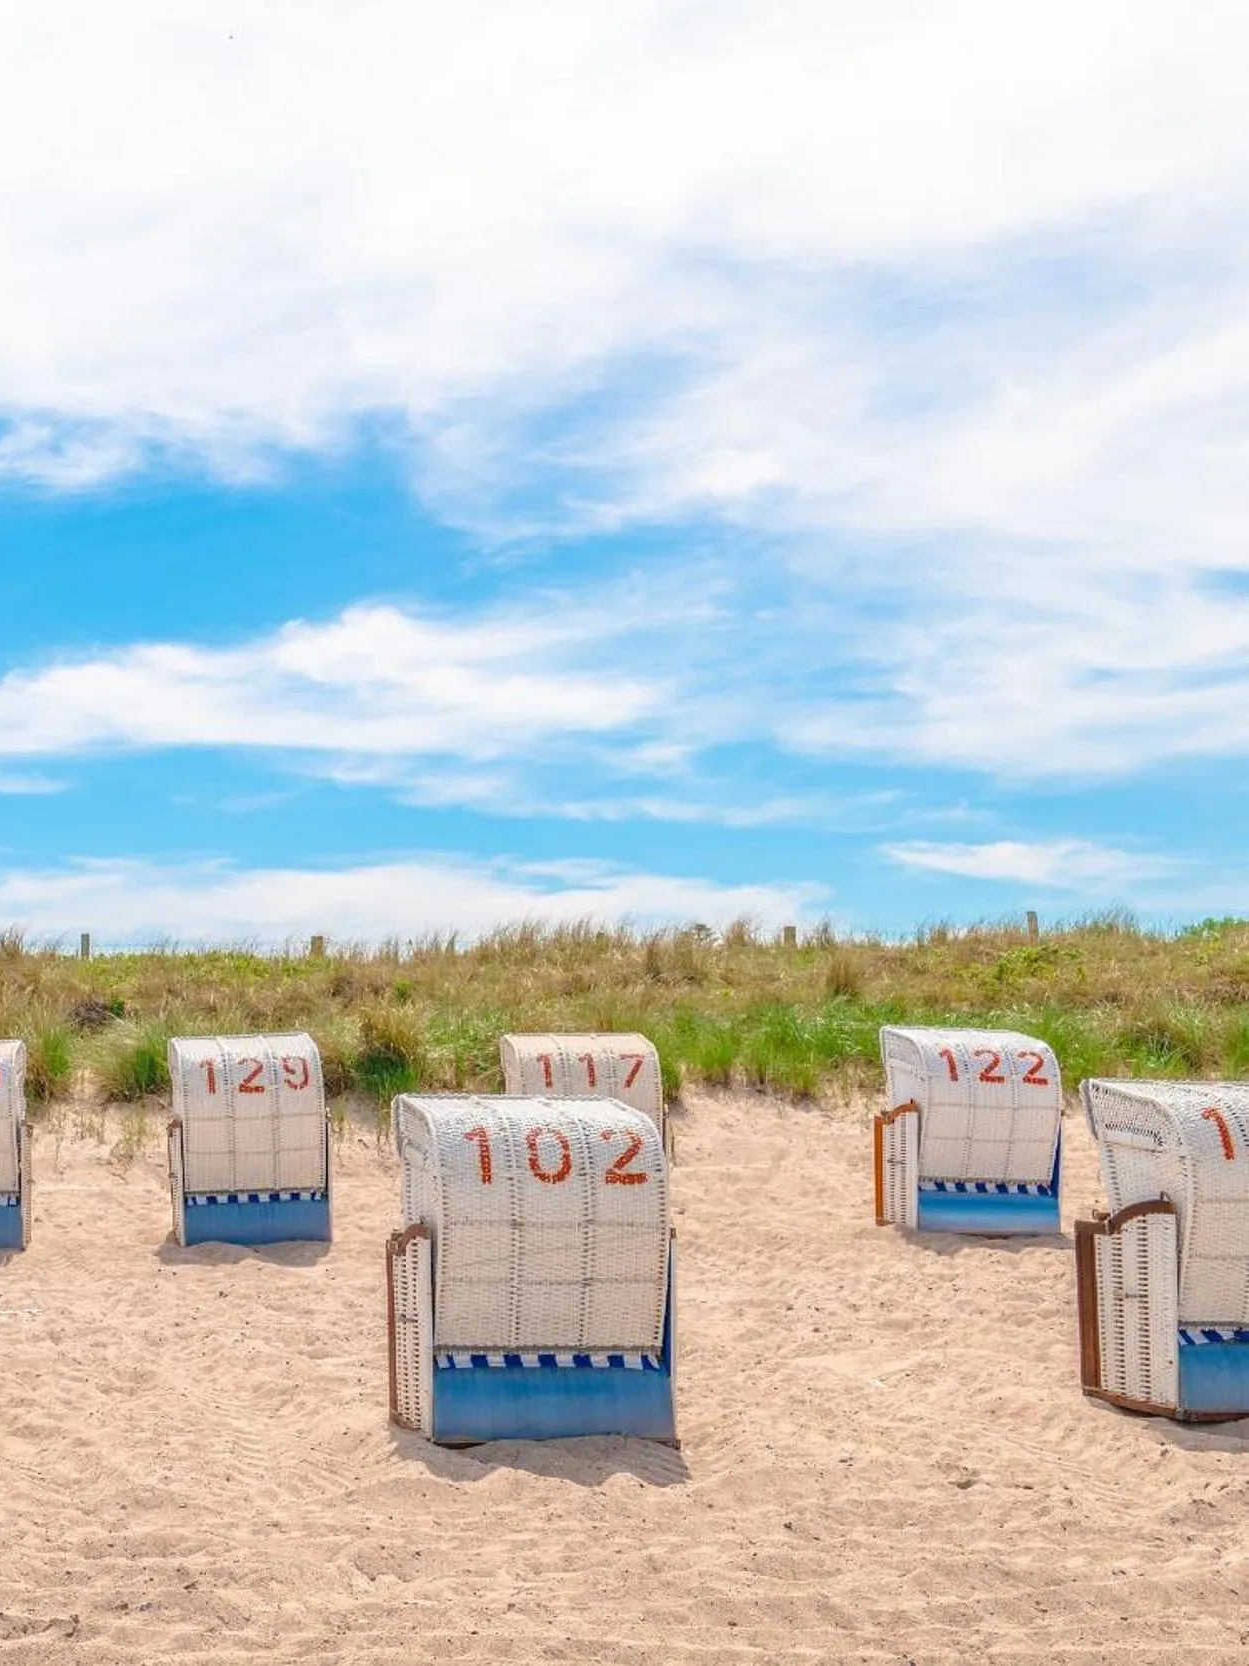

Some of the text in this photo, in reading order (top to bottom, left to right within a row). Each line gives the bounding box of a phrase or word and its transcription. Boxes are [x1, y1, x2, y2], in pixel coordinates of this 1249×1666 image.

[200, 1058, 312, 1096] 129
[539, 1053, 645, 1090] 117
[938, 1047, 1050, 1088] 122
[464, 1127, 651, 1187] 102
